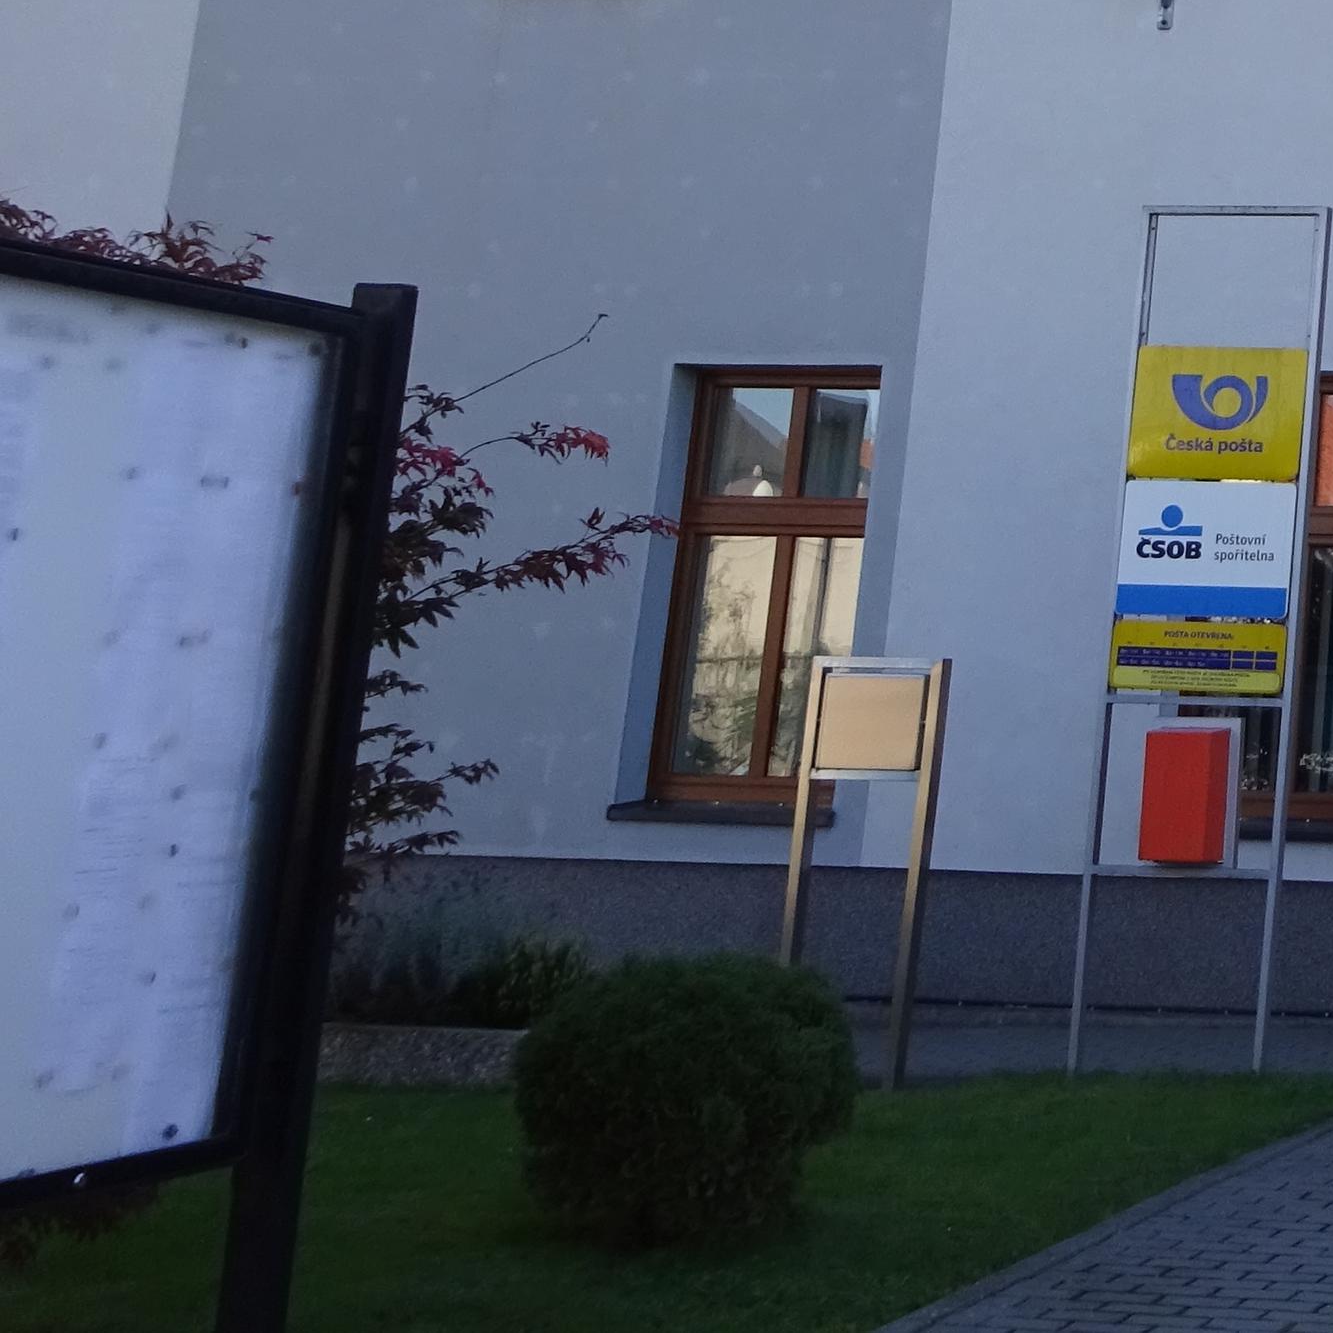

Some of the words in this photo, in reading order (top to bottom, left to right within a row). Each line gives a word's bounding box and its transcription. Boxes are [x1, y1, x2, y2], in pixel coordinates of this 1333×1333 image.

[1165, 433, 1213, 452] Česká
[1217, 438, 1264, 455] pošta
[1136, 537, 1202, 560] ČSOB
[1215, 533, 1267, 546] Poštovní
[1214, 549, 1275, 563] spořitelna
